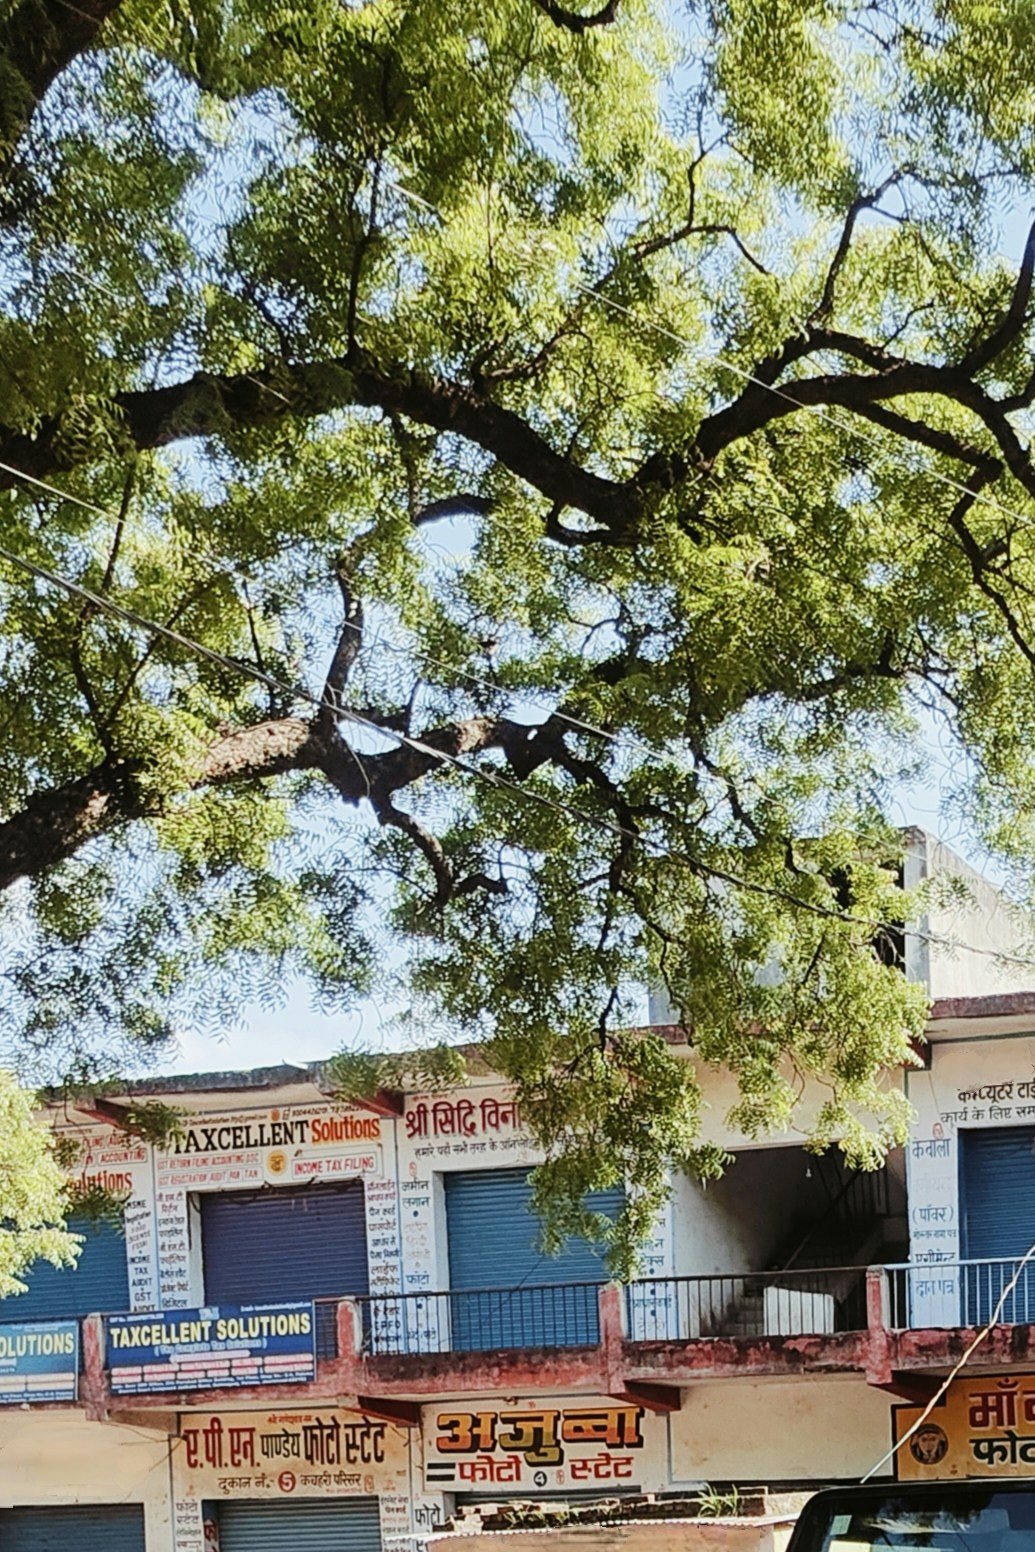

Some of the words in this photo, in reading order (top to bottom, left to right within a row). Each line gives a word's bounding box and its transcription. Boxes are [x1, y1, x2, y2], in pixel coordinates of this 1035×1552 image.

[406, 1101, 428, 1139] श्री
[480, 1098, 524, 1131] विना
[940, 1107, 968, 1127] कार्य
[972, 1106, 985, 1120] के
[169, 1120, 310, 1154] TAXCELLENT
[311, 1116, 381, 1144] Solutions
[294, 1162, 324, 1175] INCOME
[325, 1159, 343, 1172] TAX
[344, 1156, 375, 1170] FILING
[129, 1255, 151, 1265] INCOME
[134, 1266, 149, 1276] TAX
[131, 1277, 153, 1288] AUDIT
[134, 1291, 152, 1303] GST
[110, 1320, 212, 1348] TAXCELLENT
[216, 1312, 311, 1340] SOLUTIONS
[969, 1378, 1018, 1428] माँ
[260, 1428, 301, 1459] पाण्डेय
[302, 1415, 342, 1466] फोटो
[344, 1415, 388, 1465] स्टेट
[458, 1455, 522, 1483] फोटो
[569, 1452, 634, 1480] स्टेट
[217, 1475, 252, 1495] दुकान
[415, 1503, 441, 1526] फोटो
